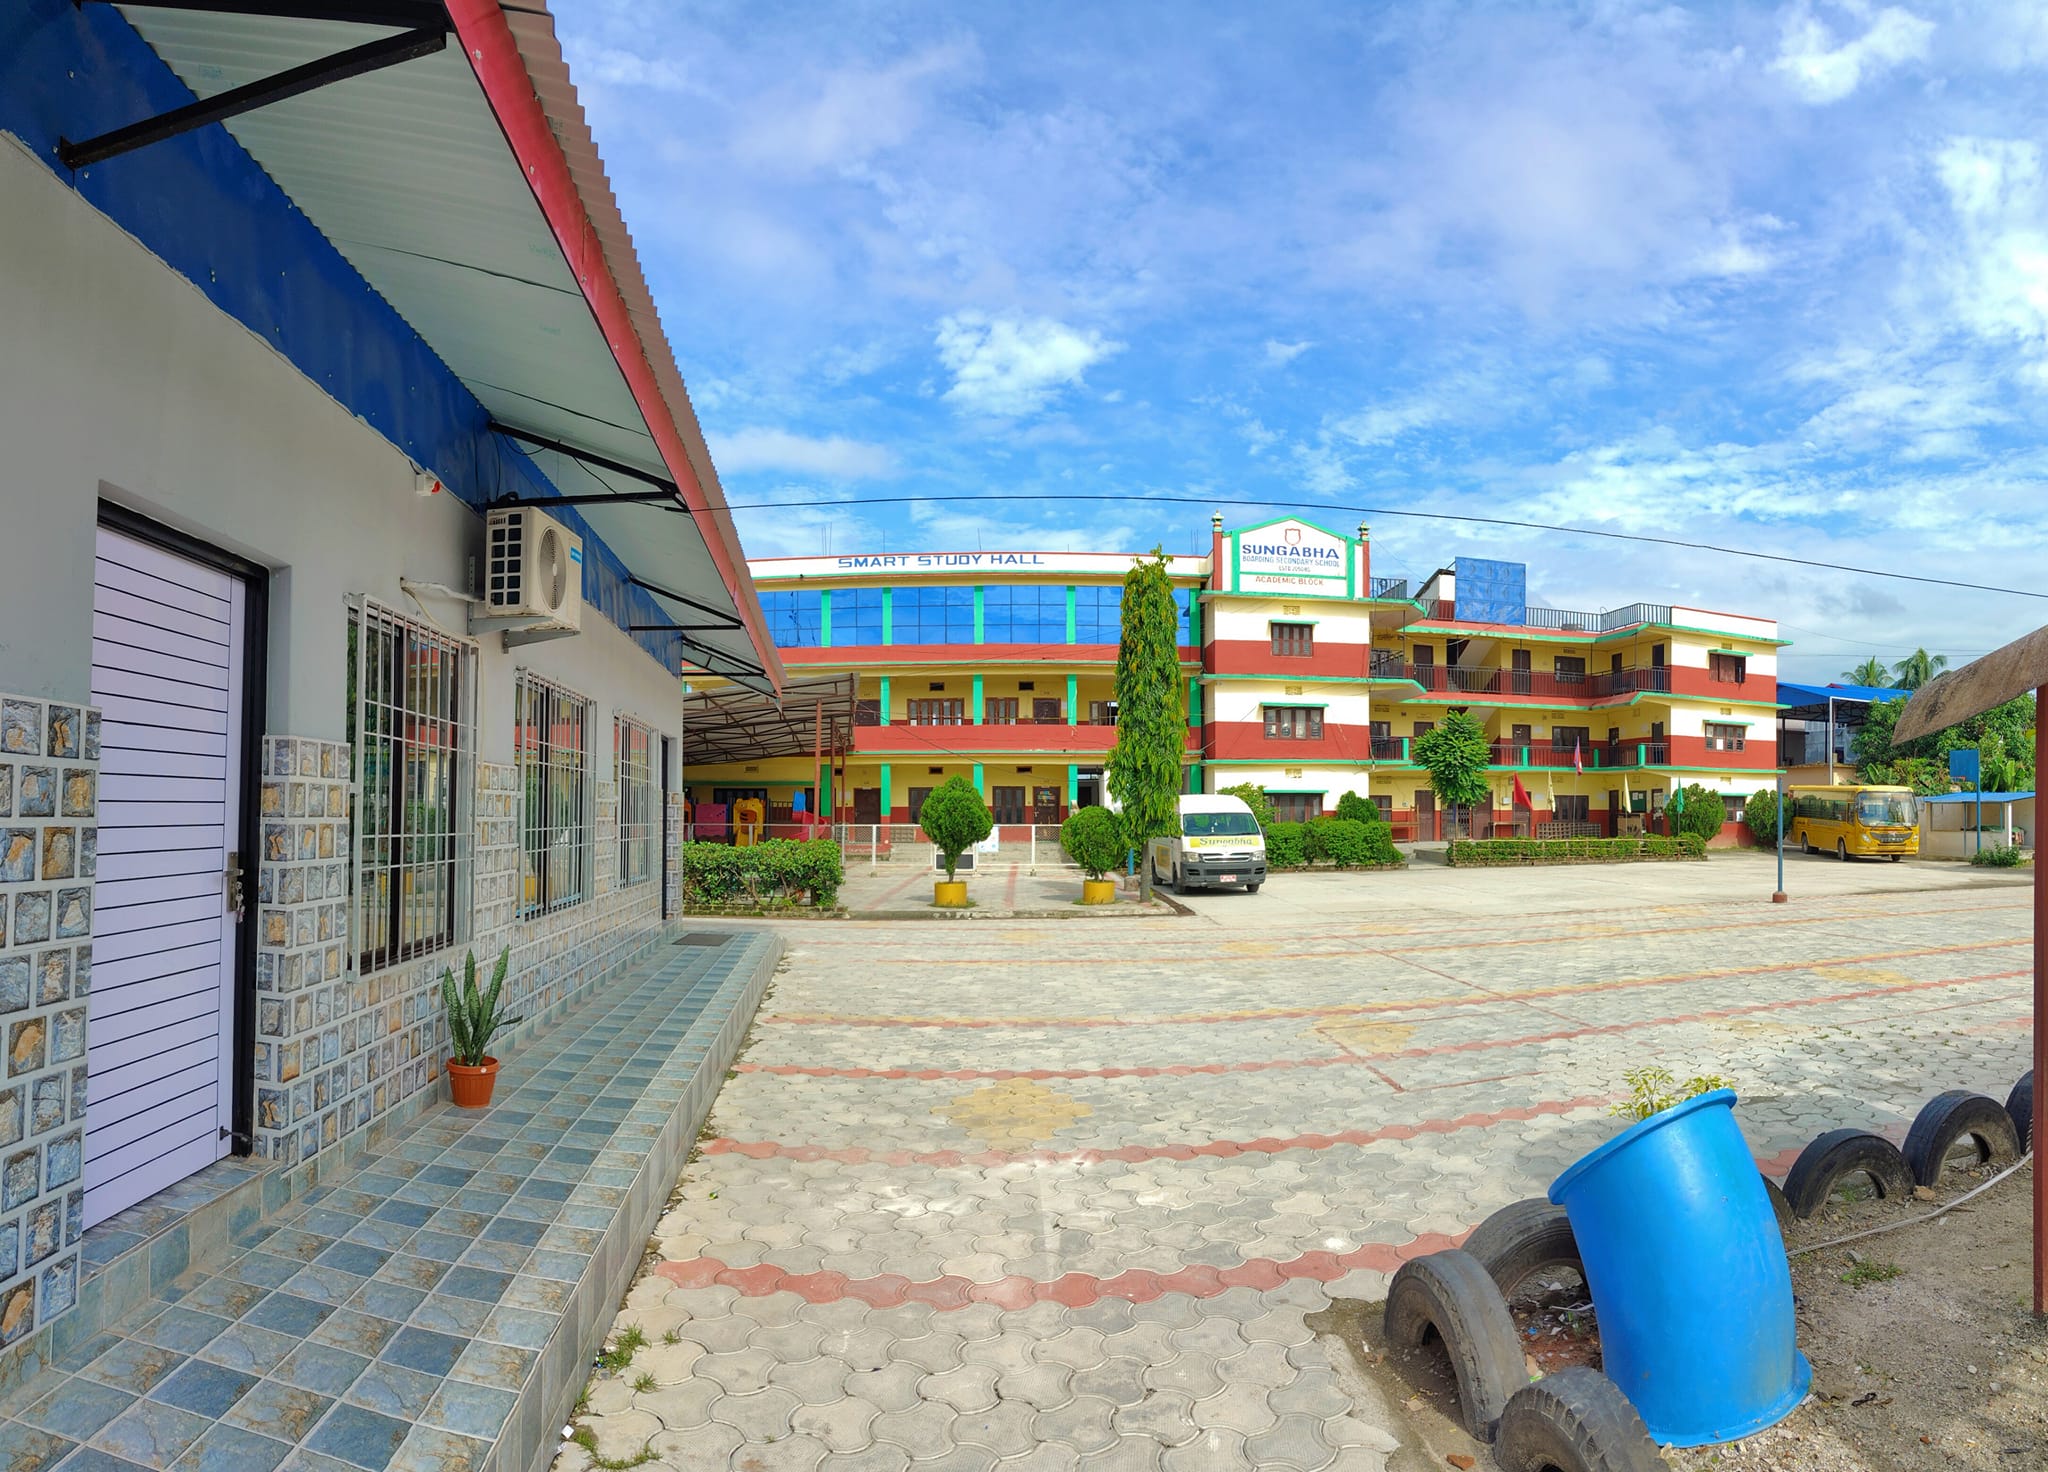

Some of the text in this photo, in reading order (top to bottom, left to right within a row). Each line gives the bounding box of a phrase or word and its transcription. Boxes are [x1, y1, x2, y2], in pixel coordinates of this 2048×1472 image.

[1242, 544, 1340, 559] SUNGABHA
[838, 554, 1045, 568] SMART STUDY HALL
[1242, 555, 1340, 568] BOARDING SECONDARY SCHOOL
[1255, 576, 1324, 586] ACADEMIC BLOCK
